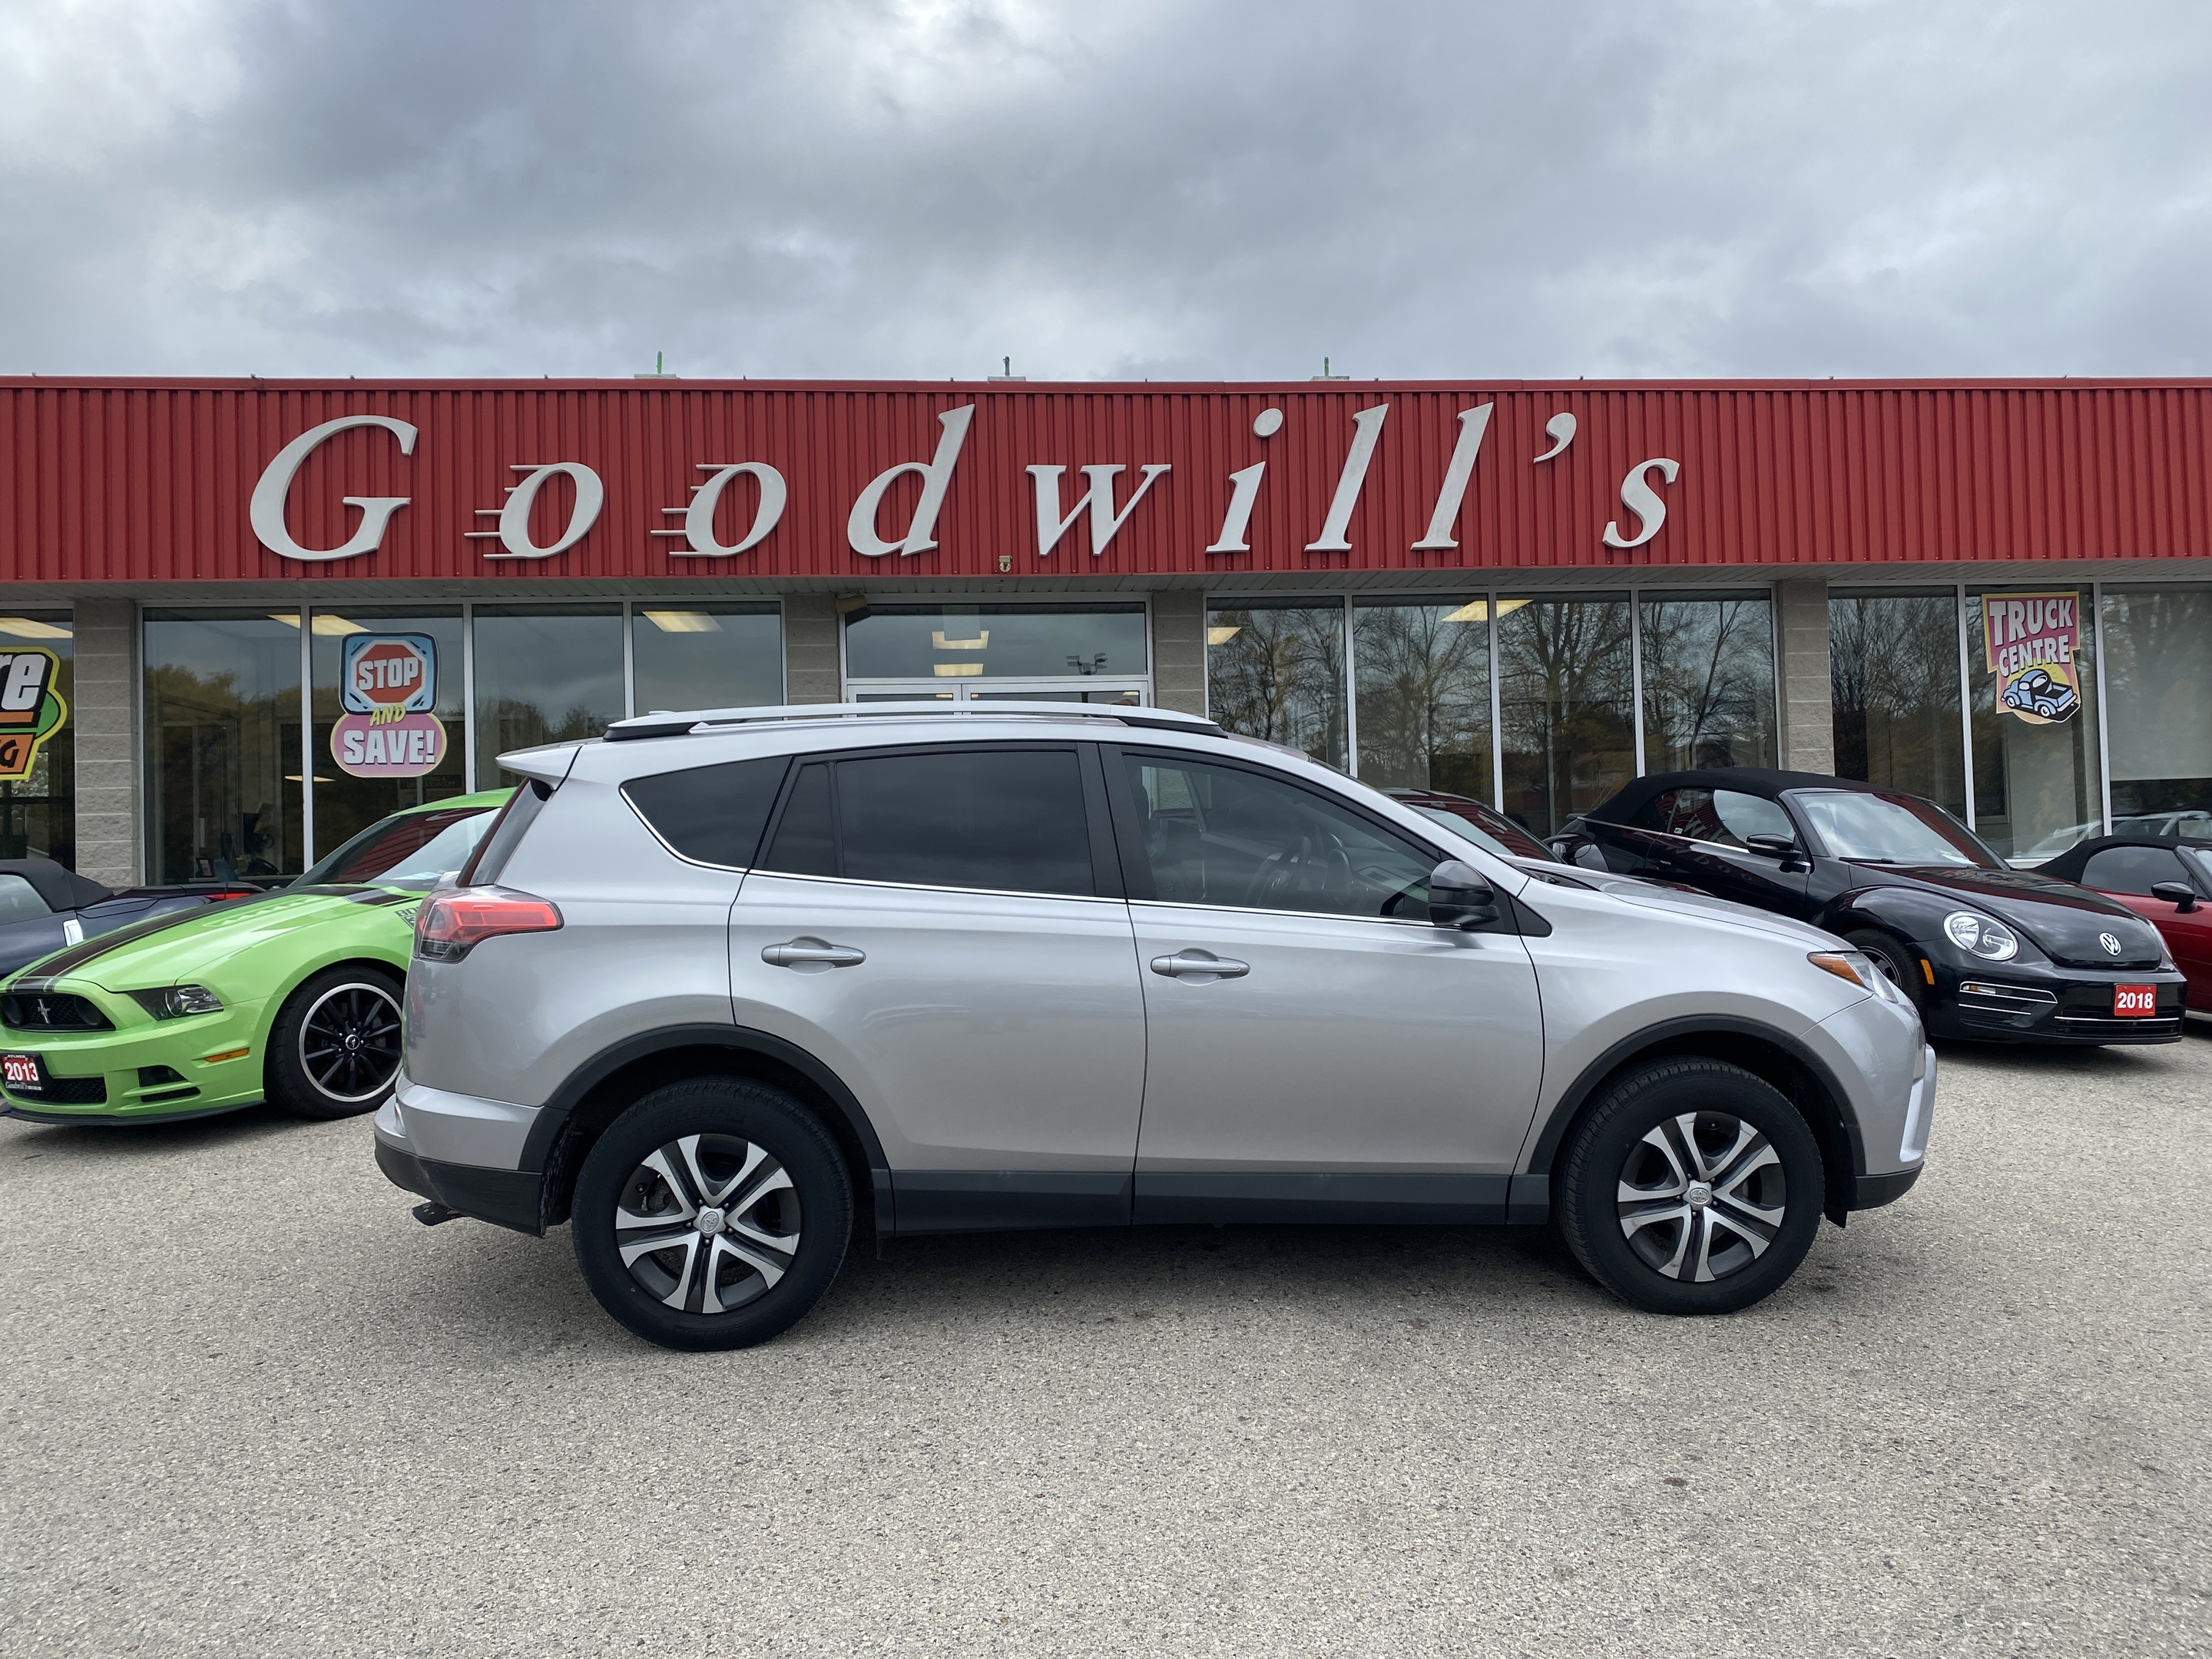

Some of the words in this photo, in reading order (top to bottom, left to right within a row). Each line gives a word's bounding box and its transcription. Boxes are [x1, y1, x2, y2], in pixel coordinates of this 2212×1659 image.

[250, 402, 1681, 561] Goodwill's
[1989, 599, 2075, 647] TRUCK
[1998, 634, 2071, 677] CENTRE
[358, 657, 419, 690] STOP
[369, 703, 406, 727] AND
[343, 730, 435, 765] SAVE!
[394, 906, 419, 917] BO
[2117, 992, 2154, 1009] 2018
[4, 1061, 38, 1081] 2013
